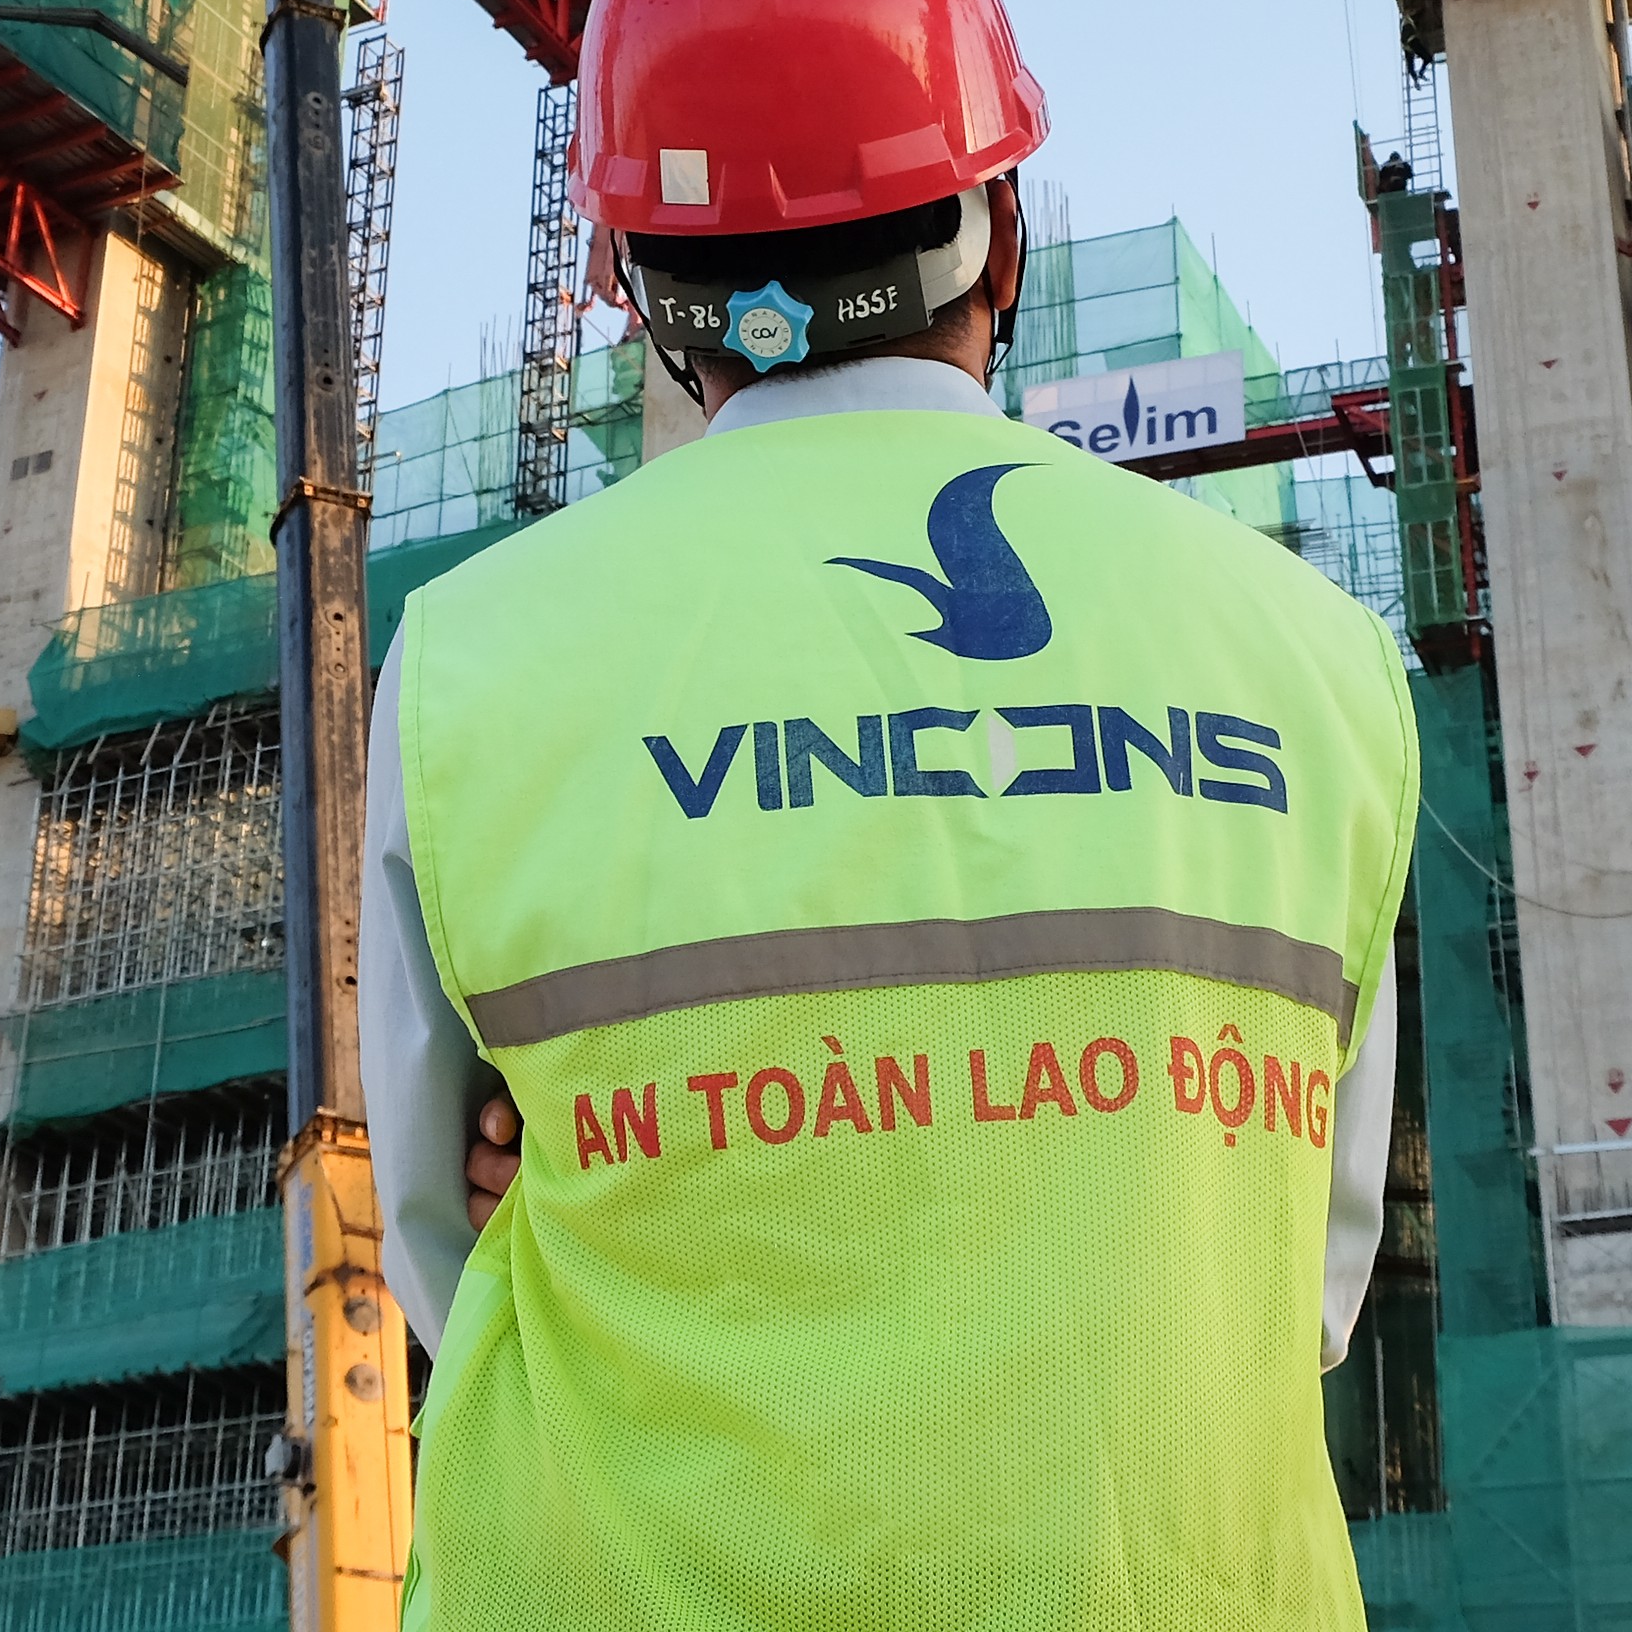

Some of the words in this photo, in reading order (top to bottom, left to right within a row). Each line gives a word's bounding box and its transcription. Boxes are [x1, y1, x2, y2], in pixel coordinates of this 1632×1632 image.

[658, 296, 721, 329] T-86
[641, 703, 1288, 819] VINCONS
[574, 1081, 662, 1170] AN
[686, 1035, 933, 1151] TOÀN
[968, 1036, 1139, 1123] LAO
[1167, 1023, 1330, 1149] ĐỘNG
